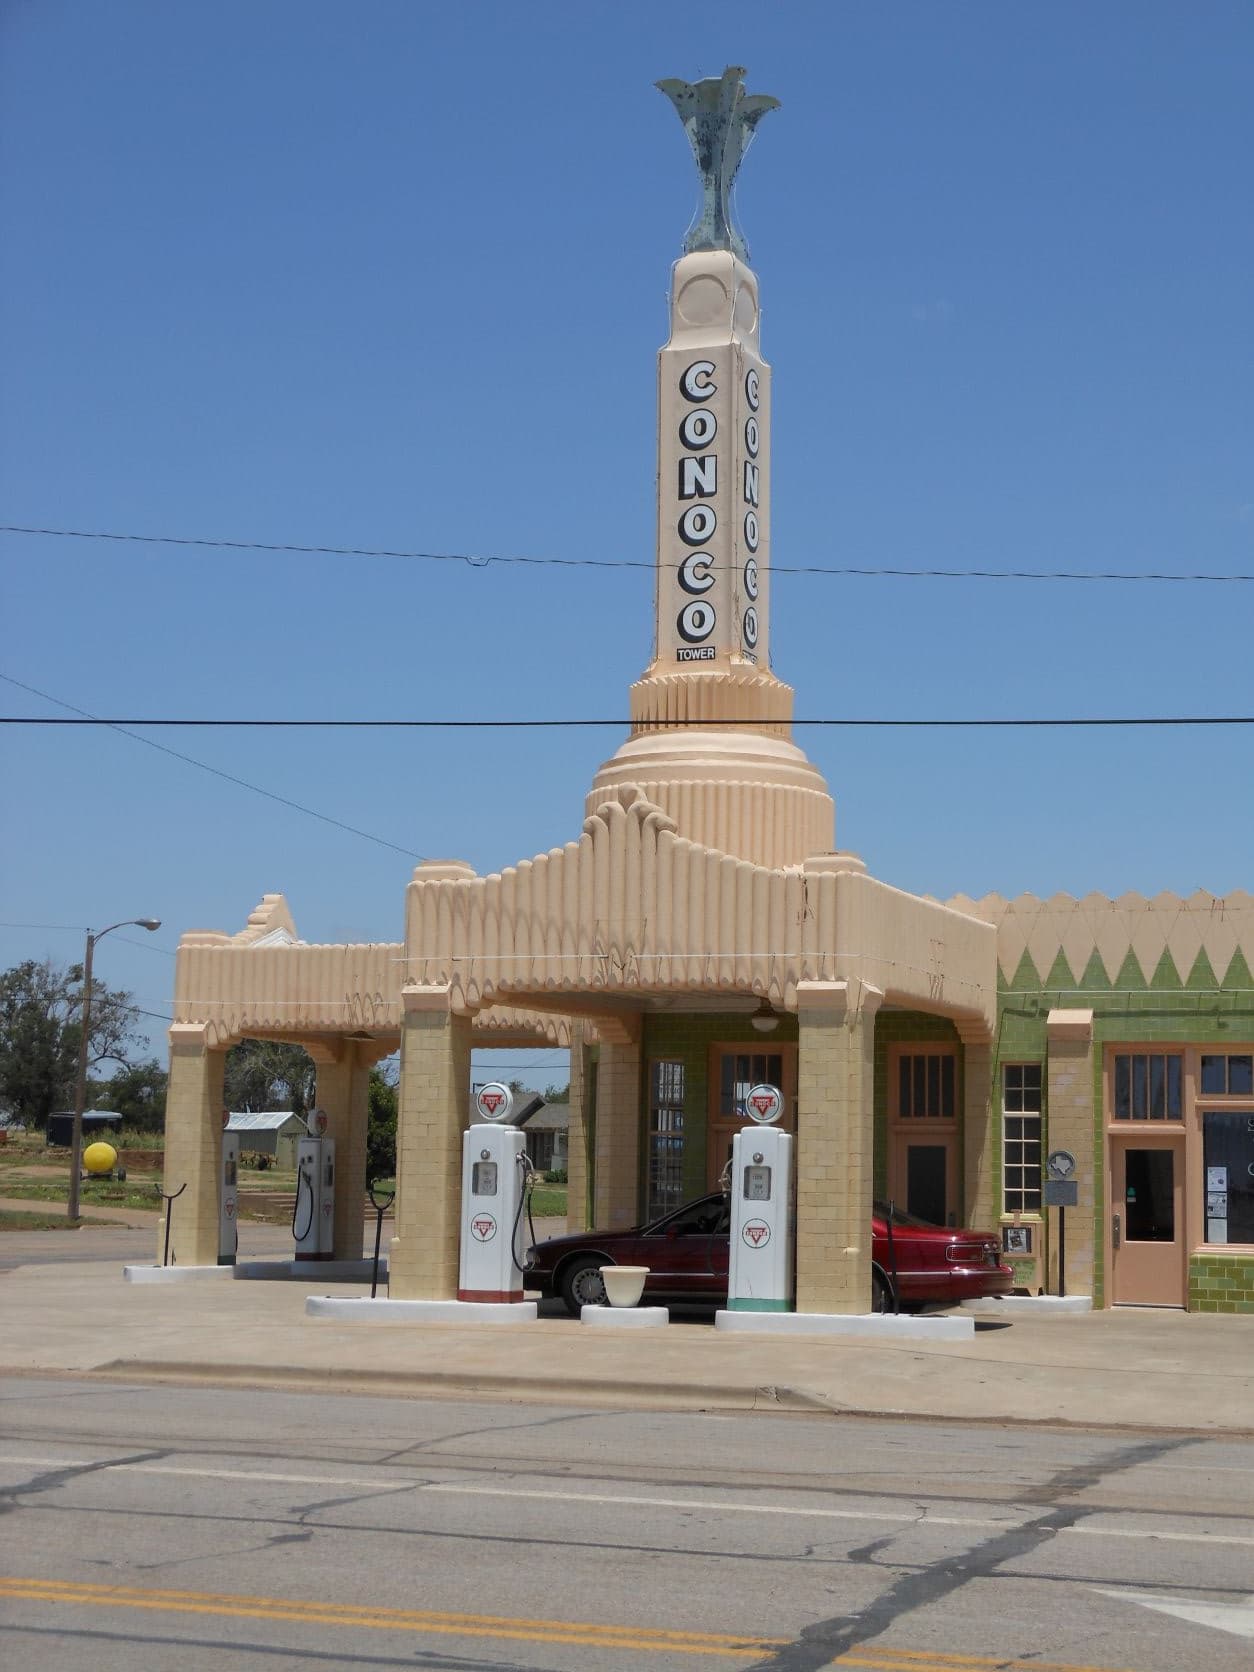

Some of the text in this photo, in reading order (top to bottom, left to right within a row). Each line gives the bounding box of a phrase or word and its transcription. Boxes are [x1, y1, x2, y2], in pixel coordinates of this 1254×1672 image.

[677, 360, 718, 643] CONOCO
[743, 368, 760, 650] CONOCO
[678, 647, 715, 661] TOWER
